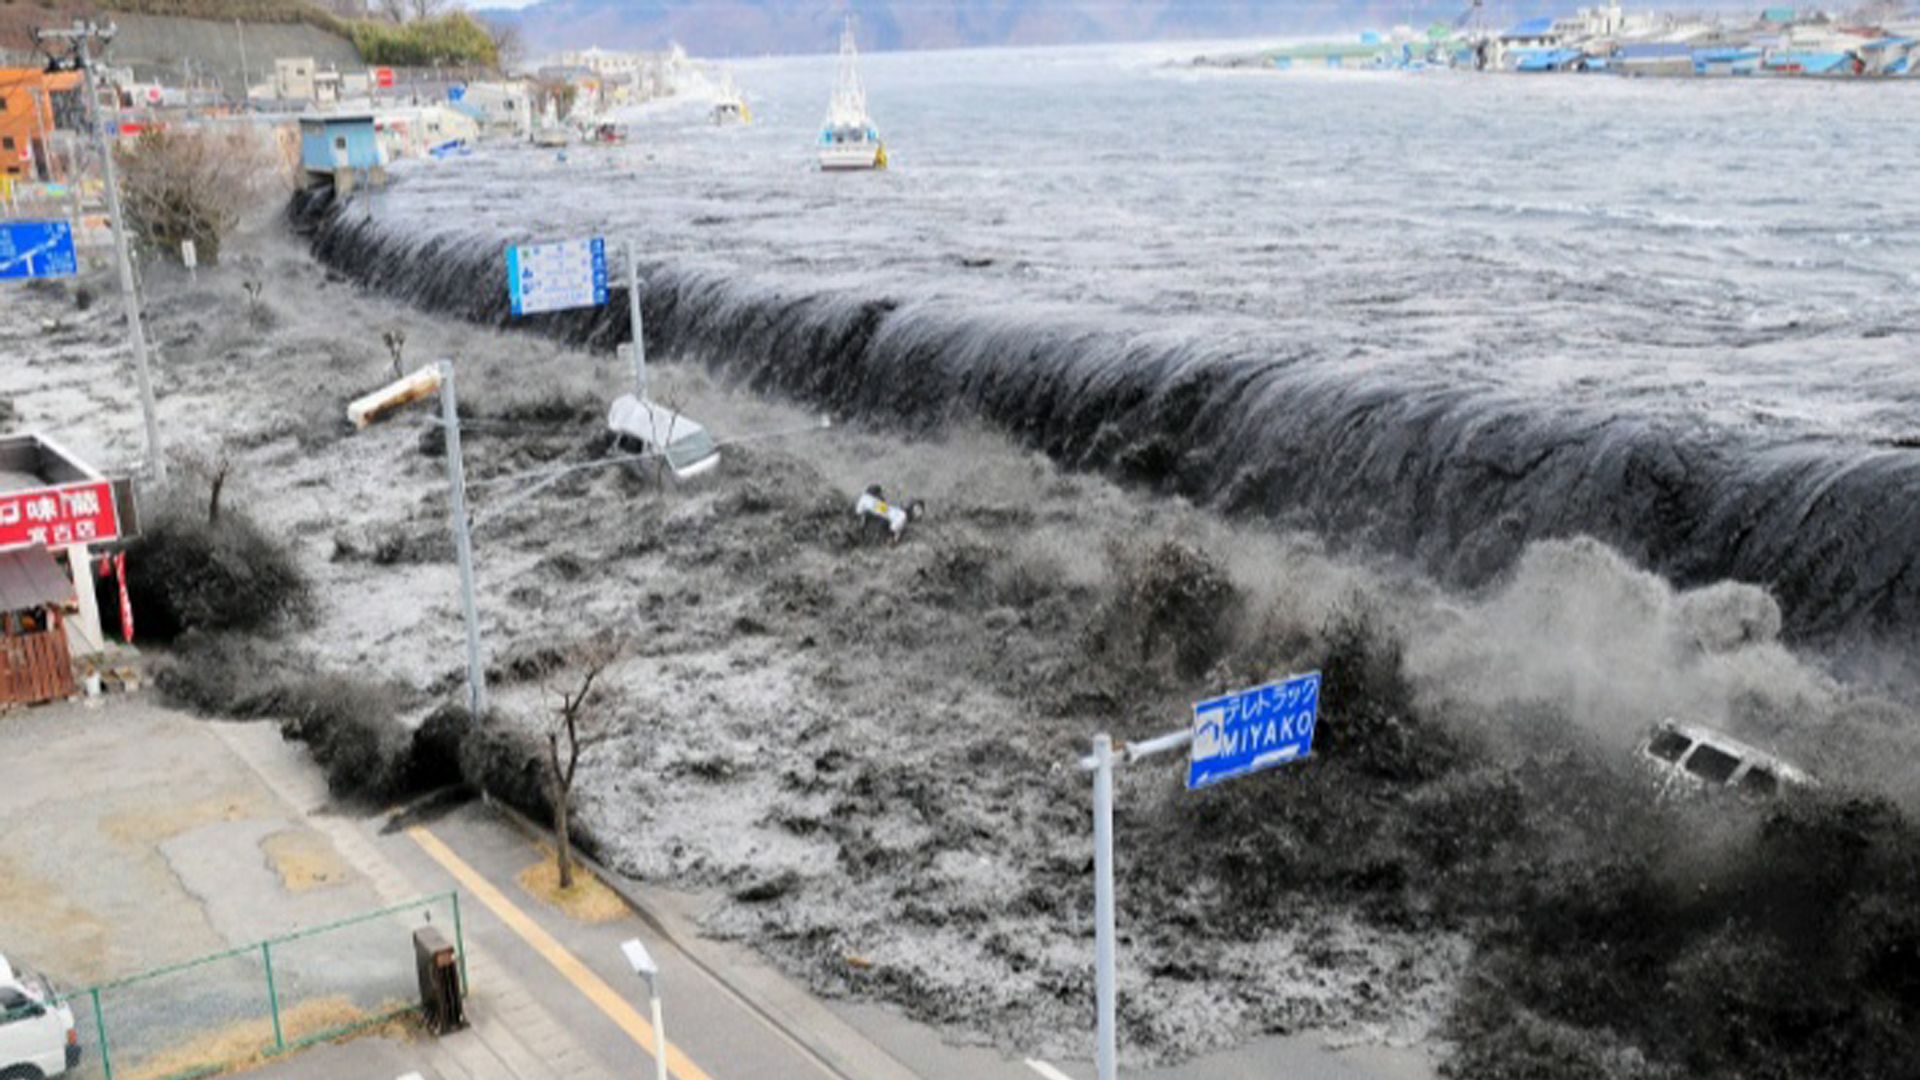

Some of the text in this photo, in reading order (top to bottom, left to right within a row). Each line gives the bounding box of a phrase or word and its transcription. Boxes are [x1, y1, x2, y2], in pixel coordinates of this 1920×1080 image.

[1224, 679, 1317, 727] テレトラック
[1221, 710, 1312, 759] MIYAKO
